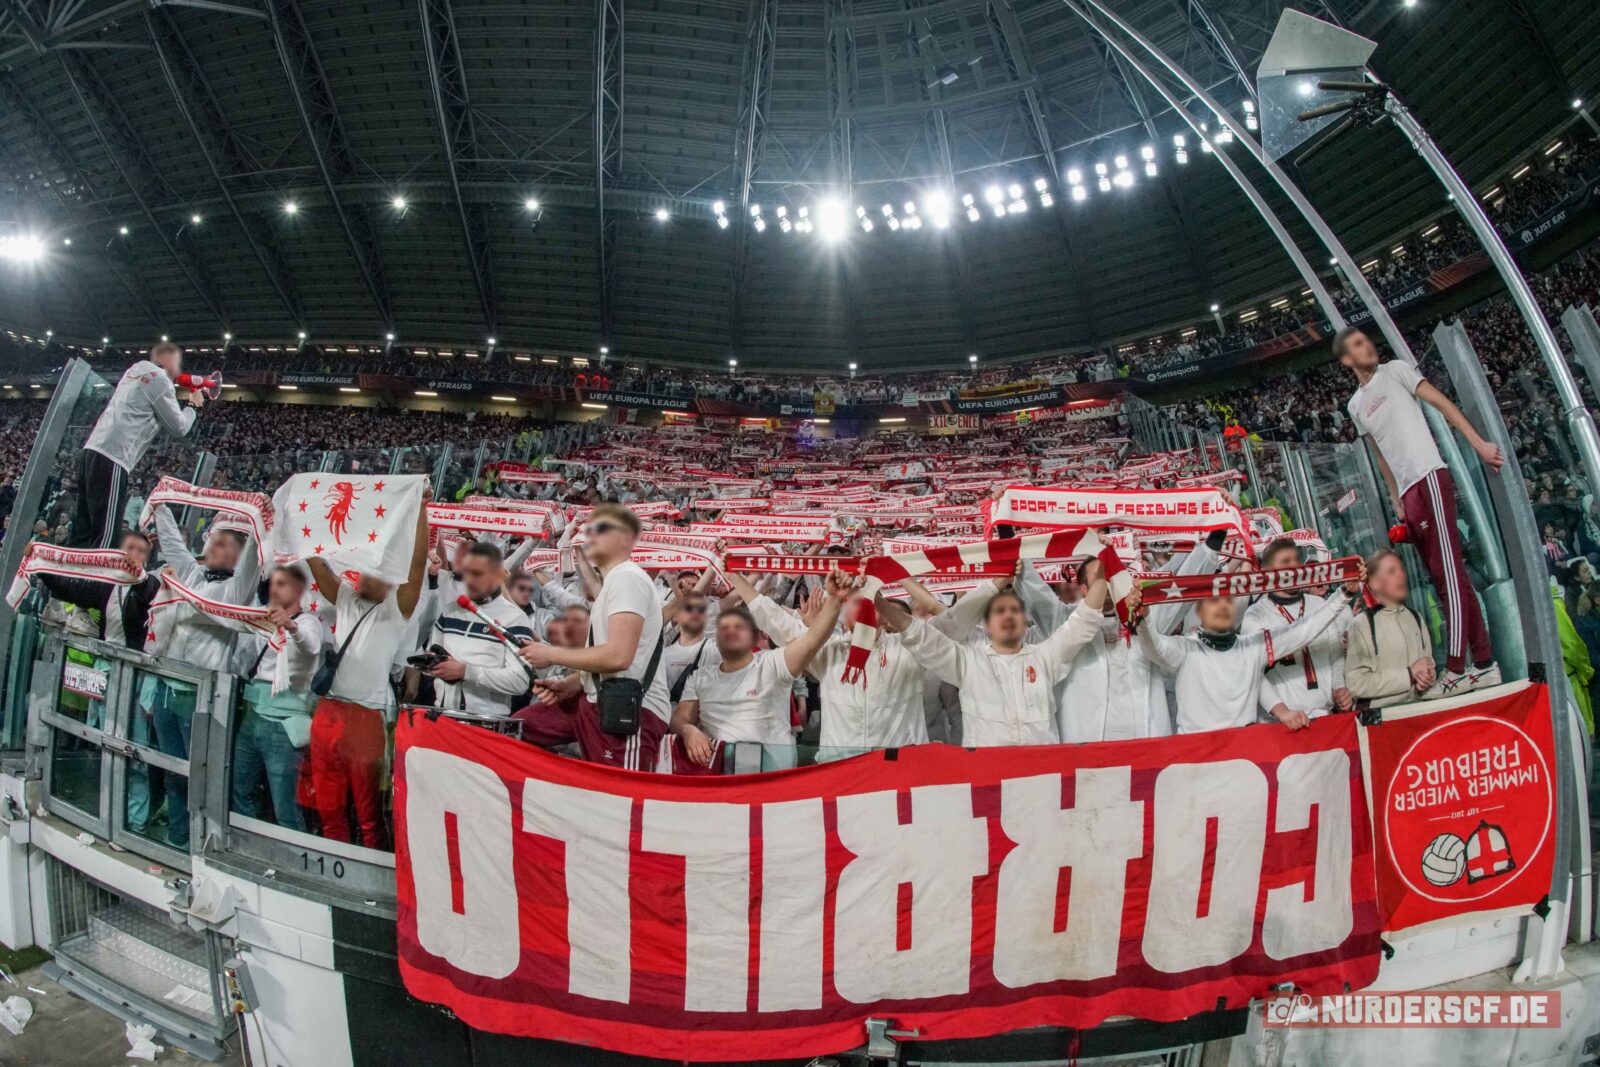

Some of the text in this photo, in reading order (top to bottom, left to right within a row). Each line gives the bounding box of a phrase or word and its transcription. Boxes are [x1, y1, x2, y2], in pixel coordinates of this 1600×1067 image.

[1533, 210, 1566, 237] JUST EAT
[1387, 286, 1425, 308] LEAGUE
[325, 376, 353, 384] LEAGUE
[1156, 365, 1200, 379] Swissquote
[437, 381, 473, 390] STRAUSS
[589, 392, 688, 408] UEFA EUROPA LEAGUE
[984, 397, 1020, 408] EUROPA
[1022, 391, 1058, 403] LEAGUE
[1011, 499, 1108, 515] SPORT-CLUB
[1115, 502, 1197, 515] FREIBURG
[459, 513, 507, 525] FREIBURG
[753, 527, 795, 535] FREIBURG
[1211, 562, 1344, 597] FREIBURG
[1406, 740, 1521, 790] FREIBURG
[1394, 764, 1539, 812] IMMER WIEDER
[301, 852, 345, 879] 110
[404, 745, 1355, 1014] CORRILLO
